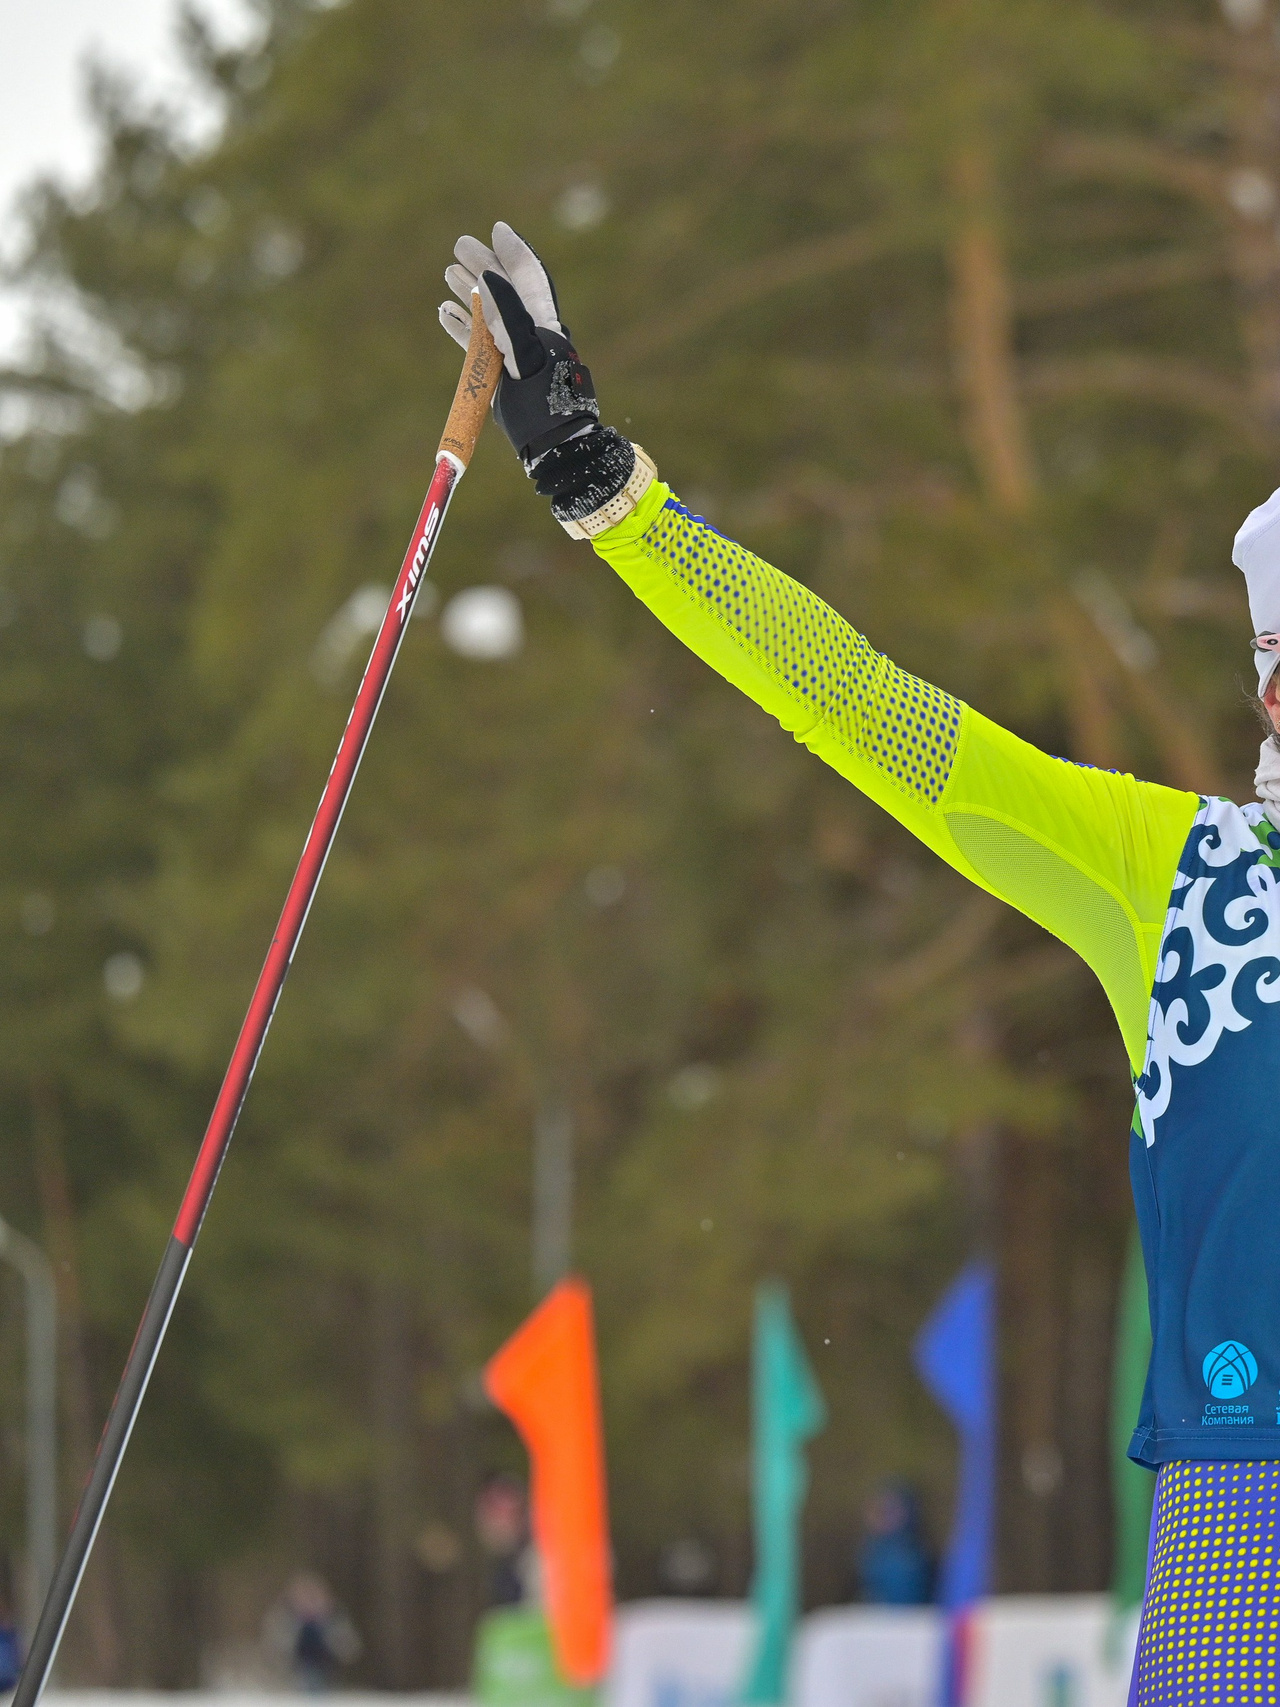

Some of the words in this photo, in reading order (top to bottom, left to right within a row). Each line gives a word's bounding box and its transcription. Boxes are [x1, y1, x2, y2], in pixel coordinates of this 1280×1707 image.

[395, 501, 440, 624] SWIX
[1204, 1403, 1249, 1415] Сетевая
[1201, 1415, 1254, 1426] Компания
